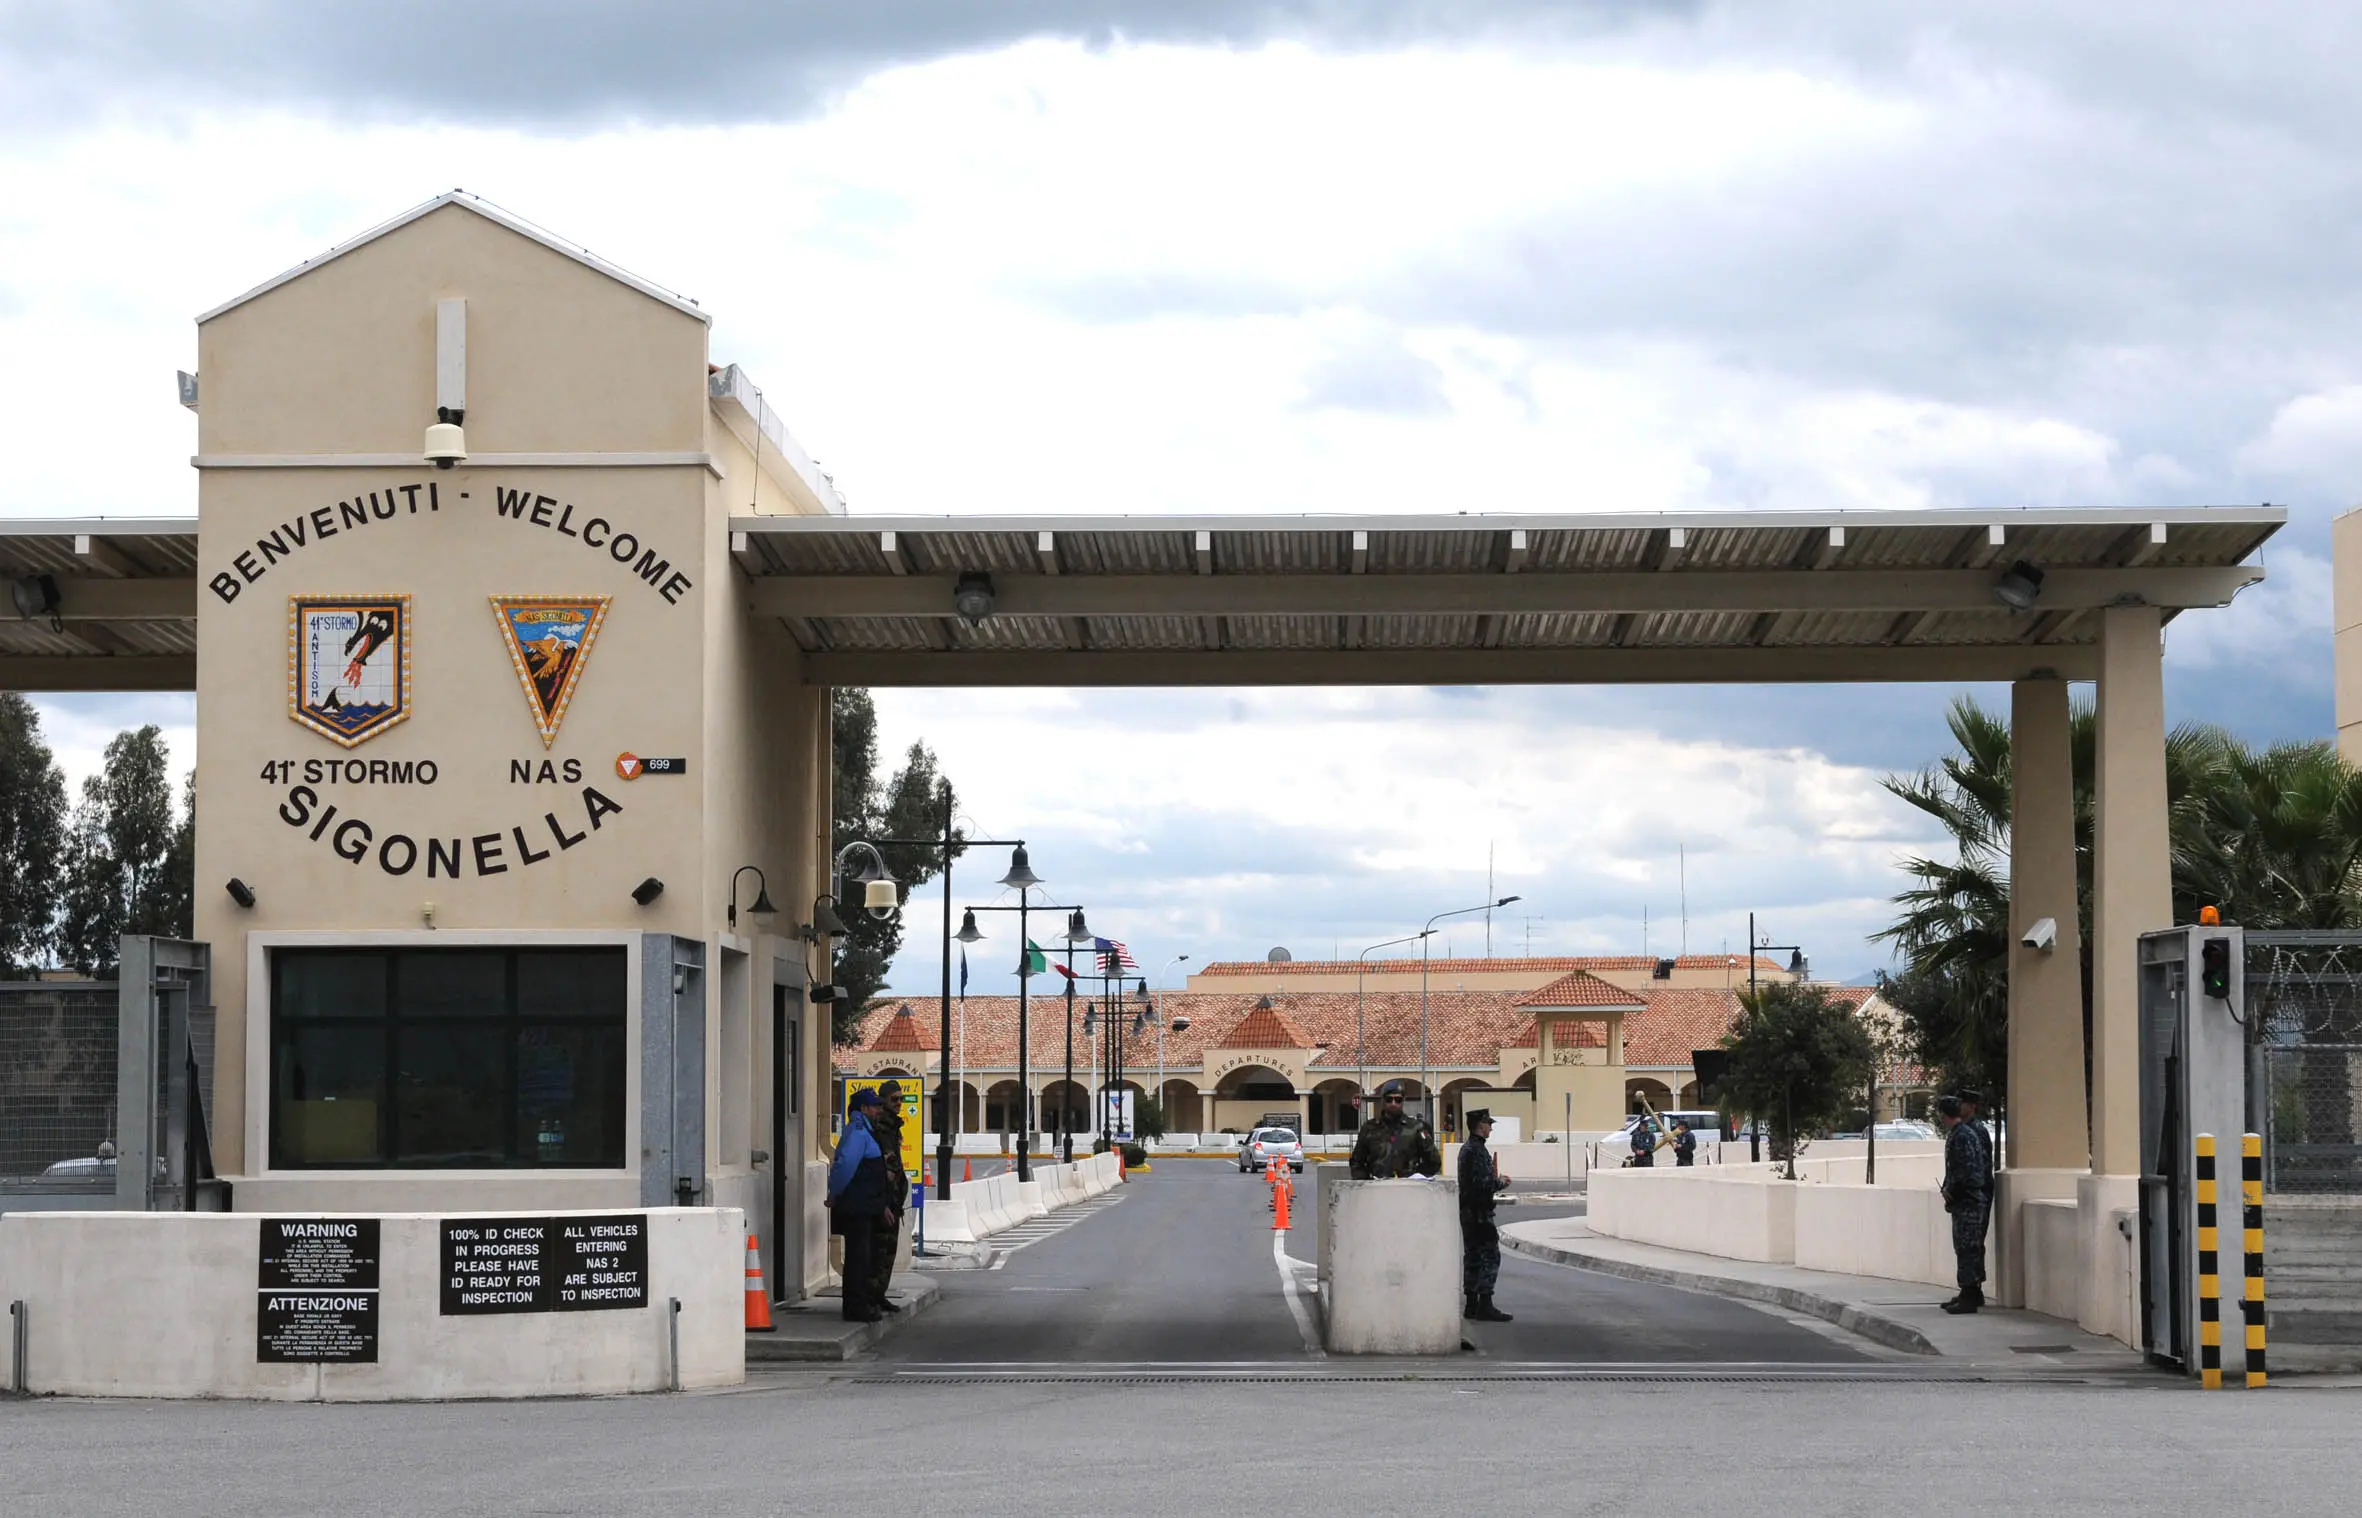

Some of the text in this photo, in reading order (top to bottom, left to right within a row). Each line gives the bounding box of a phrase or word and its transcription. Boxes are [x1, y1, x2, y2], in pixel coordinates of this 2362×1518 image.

[209, 482, 439, 604] BENVENUTI
[497, 486, 693, 605] WELCOME
[324, 616, 357, 631] STORMO
[311, 632, 319, 697] ANTISOM
[510, 758, 583, 784] NAS
[649, 759, 670, 770] 699
[303, 759, 438, 785] STORMO
[279, 785, 624, 878] SIGONELLA
[1214, 1055, 1293, 1077] DEPARTURES
[281, 1224, 358, 1237] WARNING
[449, 1227, 544, 1241] 100% ID CHECK
[564, 1225, 638, 1238] ALL VEHICLES
[456, 1244, 539, 1256] IN PROGRESS
[576, 1241, 627, 1253] ENTERING
[455, 1260, 539, 1272] PLEASE HAVE
[586, 1258, 619, 1269] NAS 2
[451, 1275, 540, 1288] ID READY FOR
[565, 1272, 638, 1285] ARE SUBJECT
[462, 1292, 533, 1304] INSPECTION
[561, 1287, 641, 1301] TO INSPECTION
[268, 1297, 368, 1311] ATTENZIONE
